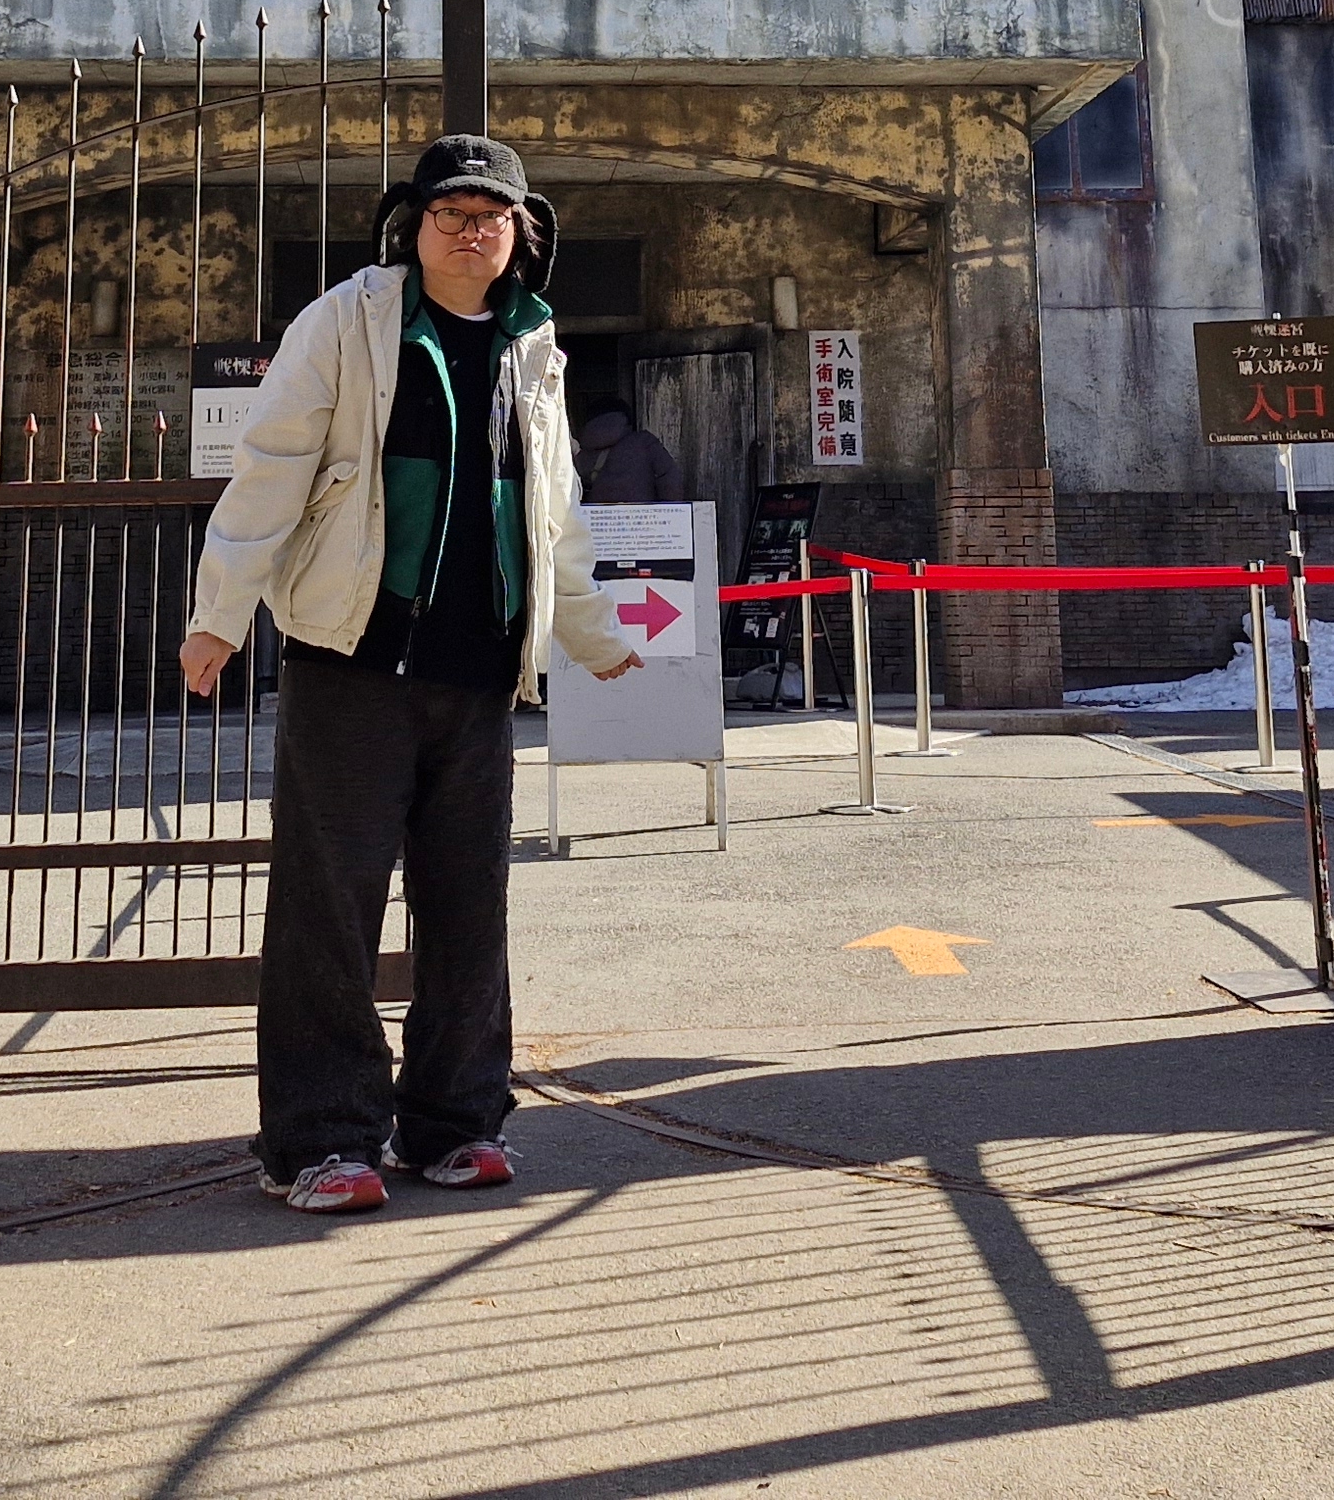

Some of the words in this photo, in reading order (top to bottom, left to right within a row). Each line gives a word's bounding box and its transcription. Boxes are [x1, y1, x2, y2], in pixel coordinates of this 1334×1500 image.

[1231, 341, 1330, 359] チケットを既に
[1238, 357, 1324, 376] 購入済みの方
[814, 337, 837, 457] 手術室完備
[837, 337, 857, 456] 入院随意
[1242, 382, 1327, 424] 入口
[1208, 432, 1258, 443] Customers
[1261, 431, 1283, 442] with
[1286, 429, 1318, 440] tickets
